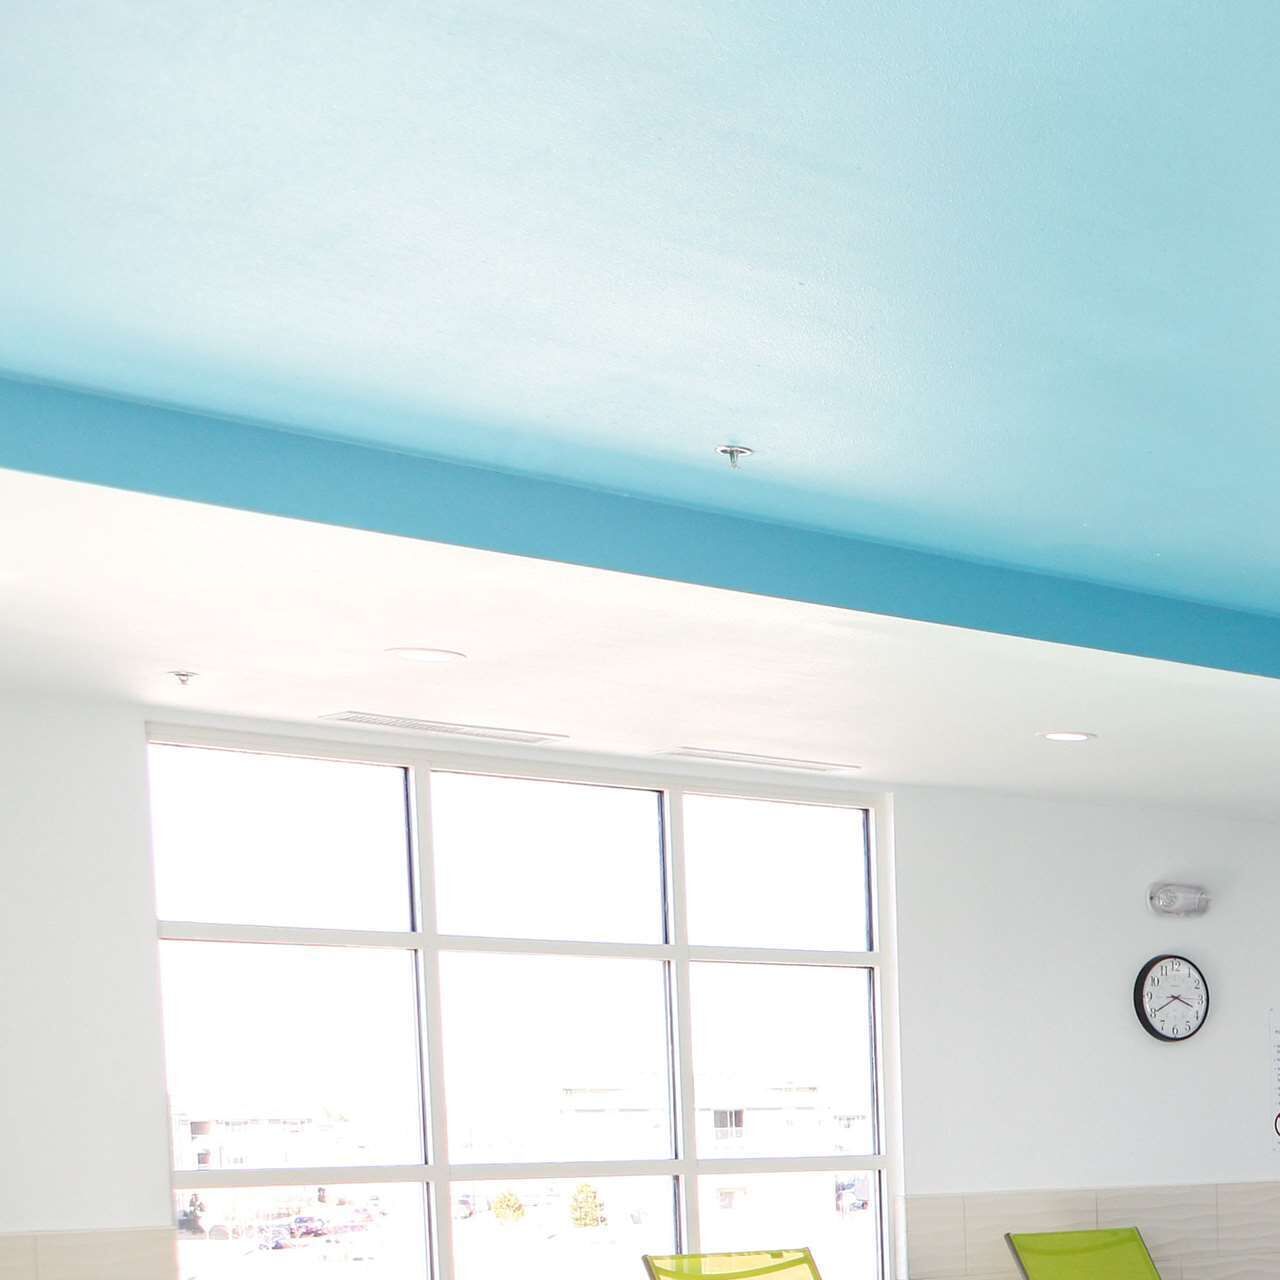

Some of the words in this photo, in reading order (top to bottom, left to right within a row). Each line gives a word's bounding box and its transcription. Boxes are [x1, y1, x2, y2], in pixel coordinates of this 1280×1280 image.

[1160, 965, 1168, 977] 11
[1170, 960, 1181, 972] 12
[1150, 975, 1160, 987] 10
[1194, 979, 1200, 990] 2
[1146, 992, 1152, 1002] 9
[1149, 1008, 1157, 1019] 8
[1160, 1019, 1165, 1031] 7
[1172, 1024, 1179, 1035] 6
[1184, 1021, 1191, 1033] 5
